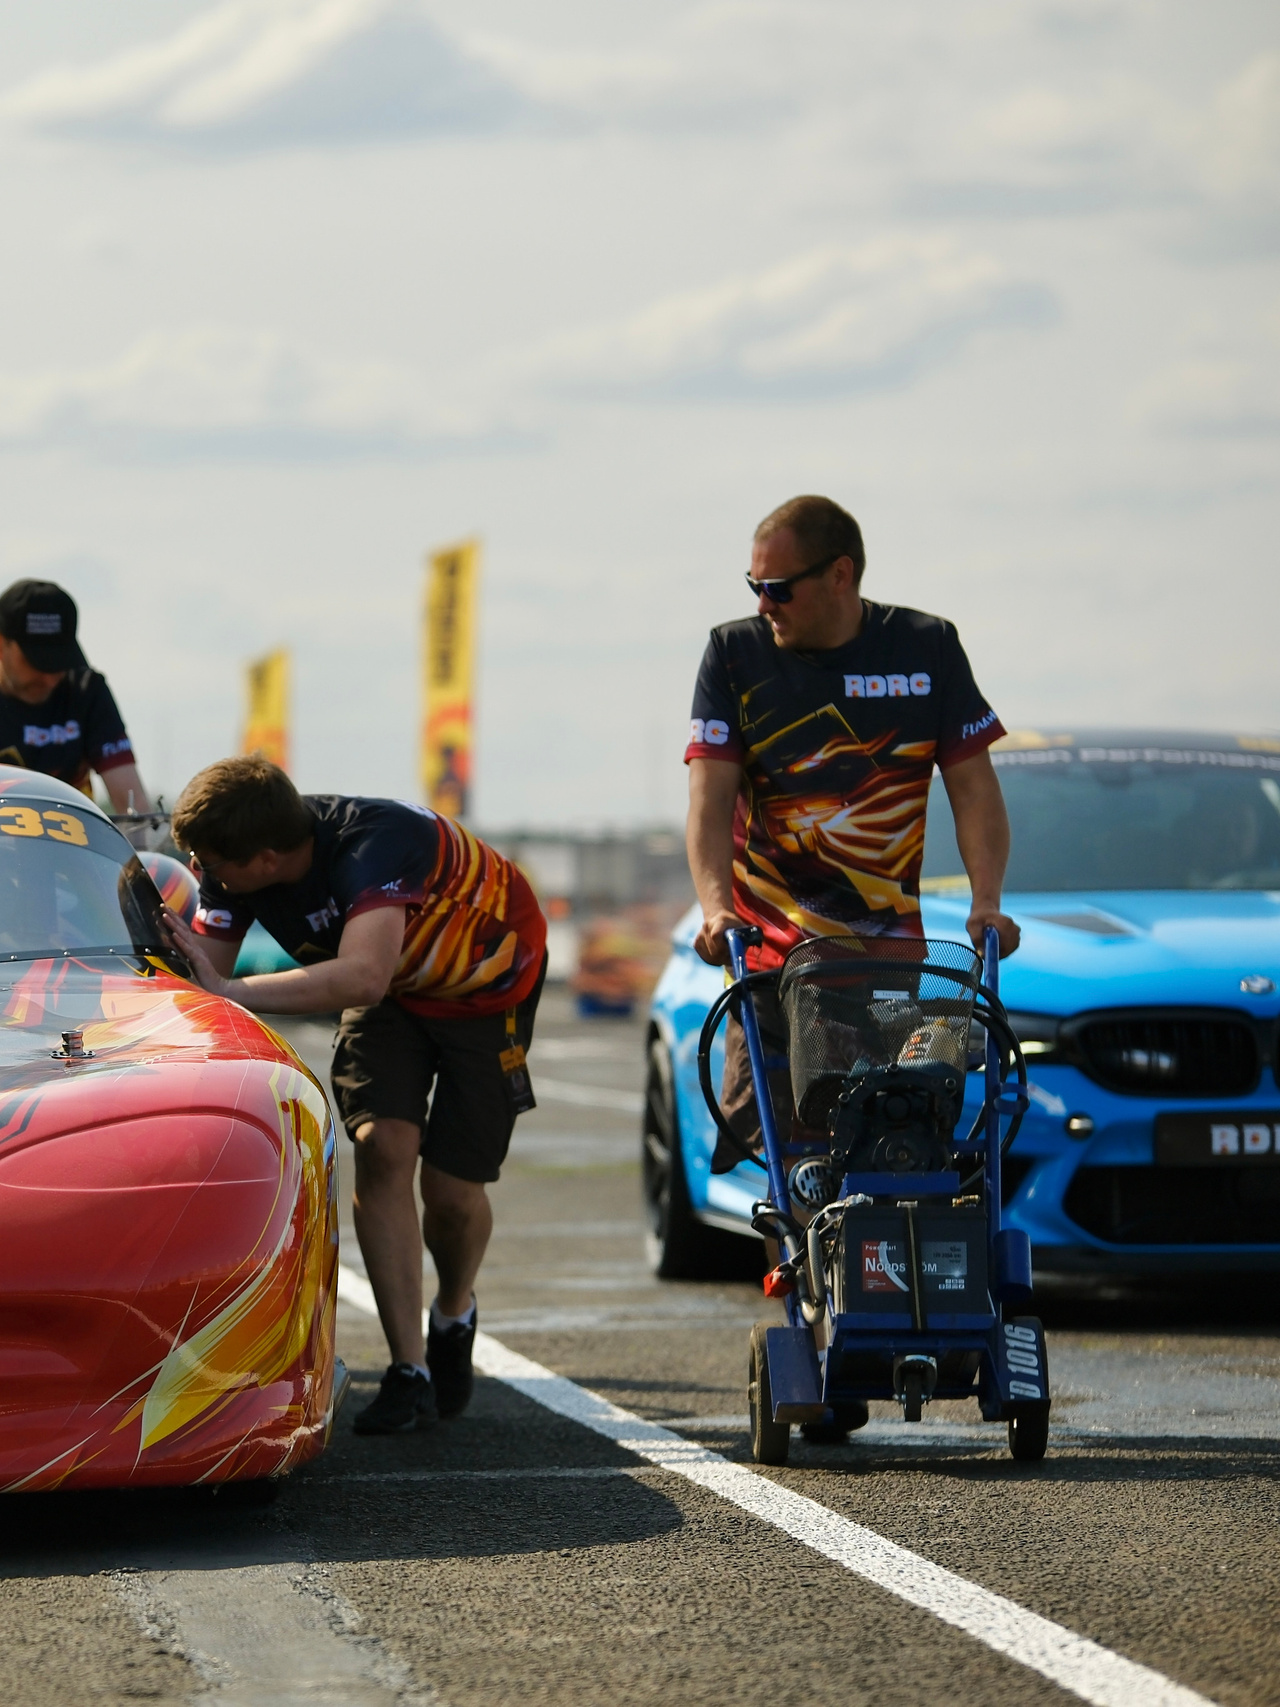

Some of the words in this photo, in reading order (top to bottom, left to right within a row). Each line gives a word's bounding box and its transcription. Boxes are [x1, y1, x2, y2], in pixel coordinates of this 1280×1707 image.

[843, 672, 931, 698] RDRC
[1210, 1123, 1280, 1155] RD
[1003, 1323, 1039, 1377] 1016
